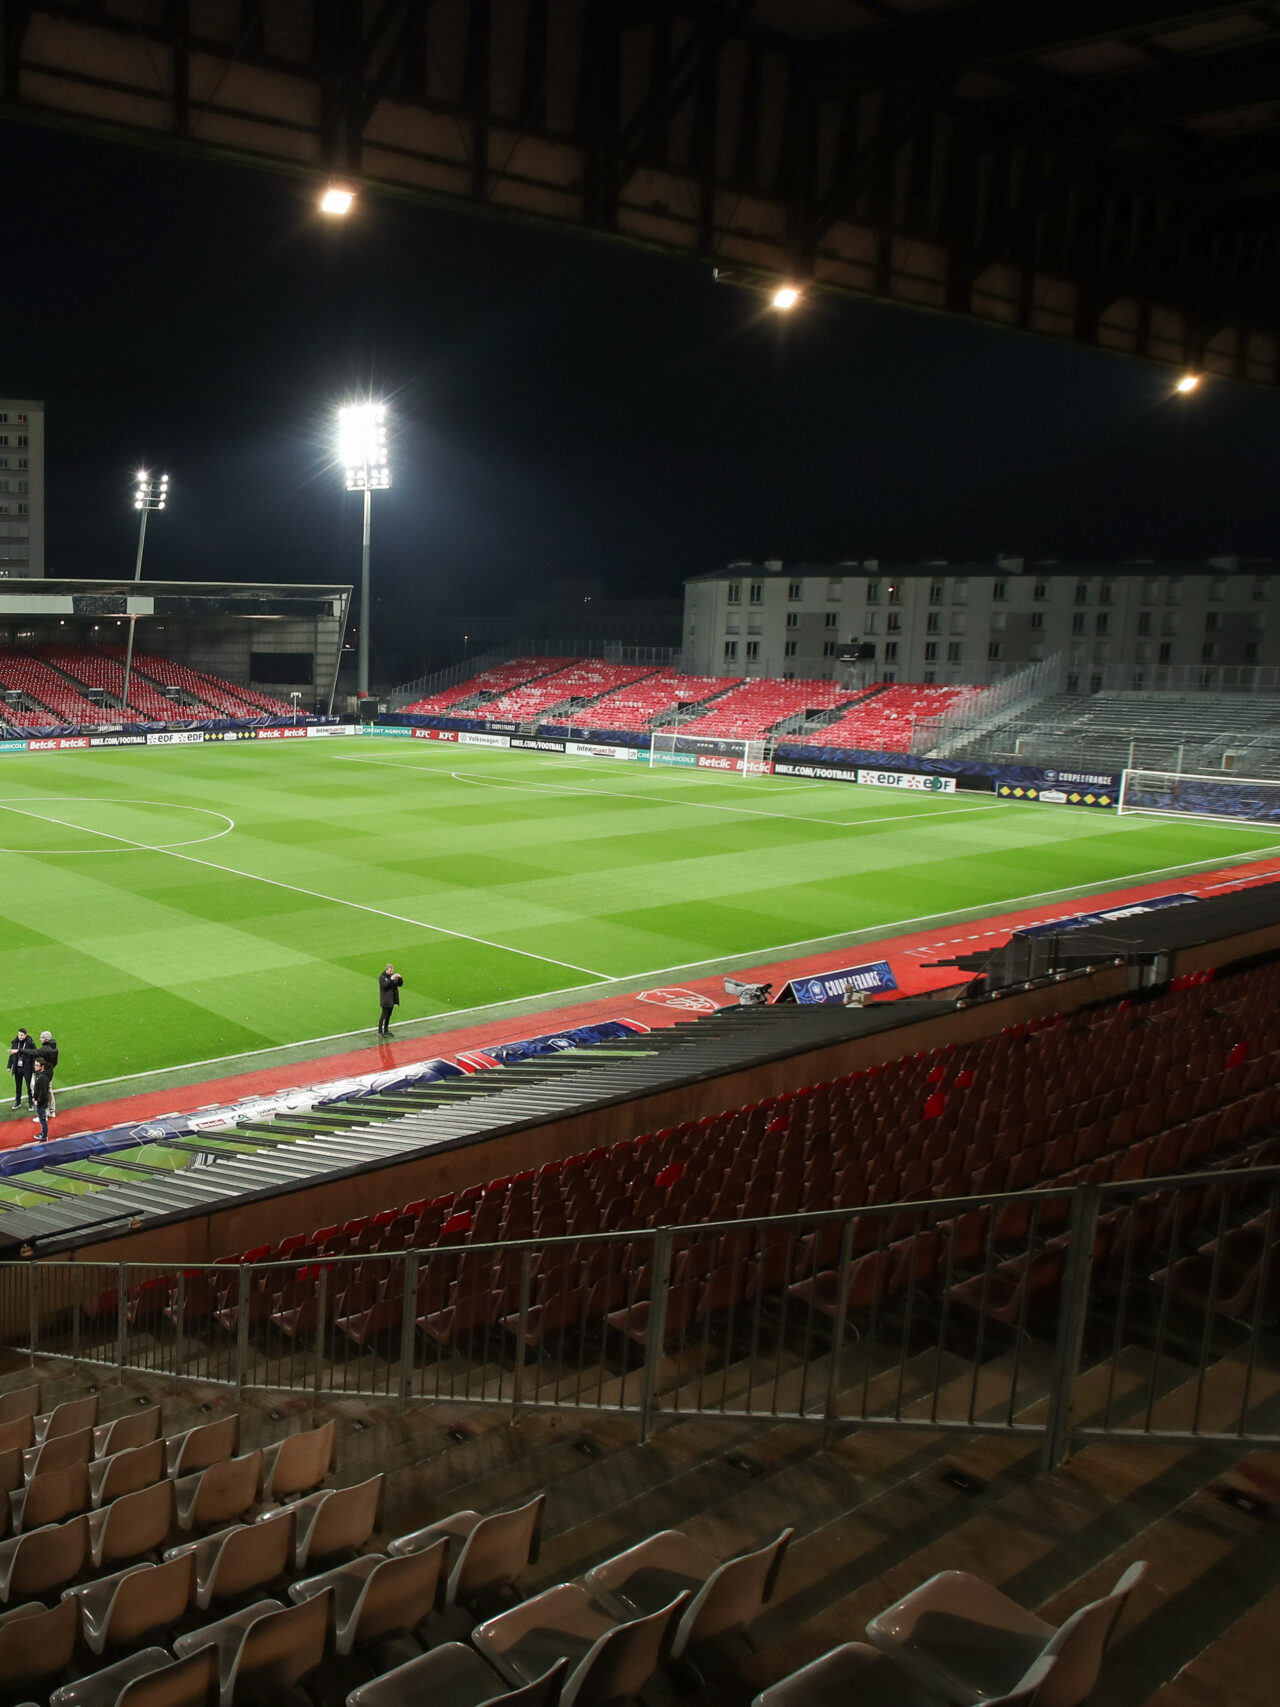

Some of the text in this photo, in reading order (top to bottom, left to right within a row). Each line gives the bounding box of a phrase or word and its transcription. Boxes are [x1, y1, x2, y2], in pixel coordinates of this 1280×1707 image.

[258, 729, 281, 739] Betclic
[283, 728, 307, 737] Betclic
[415, 729, 431, 738] KFC
[438, 731, 455, 741] KFC
[29, 739, 57, 750] Betclic
[60, 738, 87, 748] Betclic
[91, 735, 146, 746] NIKE.COM/FOOTBALL
[468, 735, 500, 745] Volkswagen
[511, 739, 565, 751] NIKE.COM/FOOTBALL
[662, 755, 696, 763] AGRICOLE
[698, 756, 731, 769] Betclic
[736, 758, 771, 773] Btclic
[775, 764, 856, 782] NIKE.COM/FOOTBALL
[1058, 772, 1081, 782] COUPE
[1085, 774, 1113, 785] FRANCE
[824, 978, 848, 997] COUPE
[852, 971, 882, 991] FRANCE
